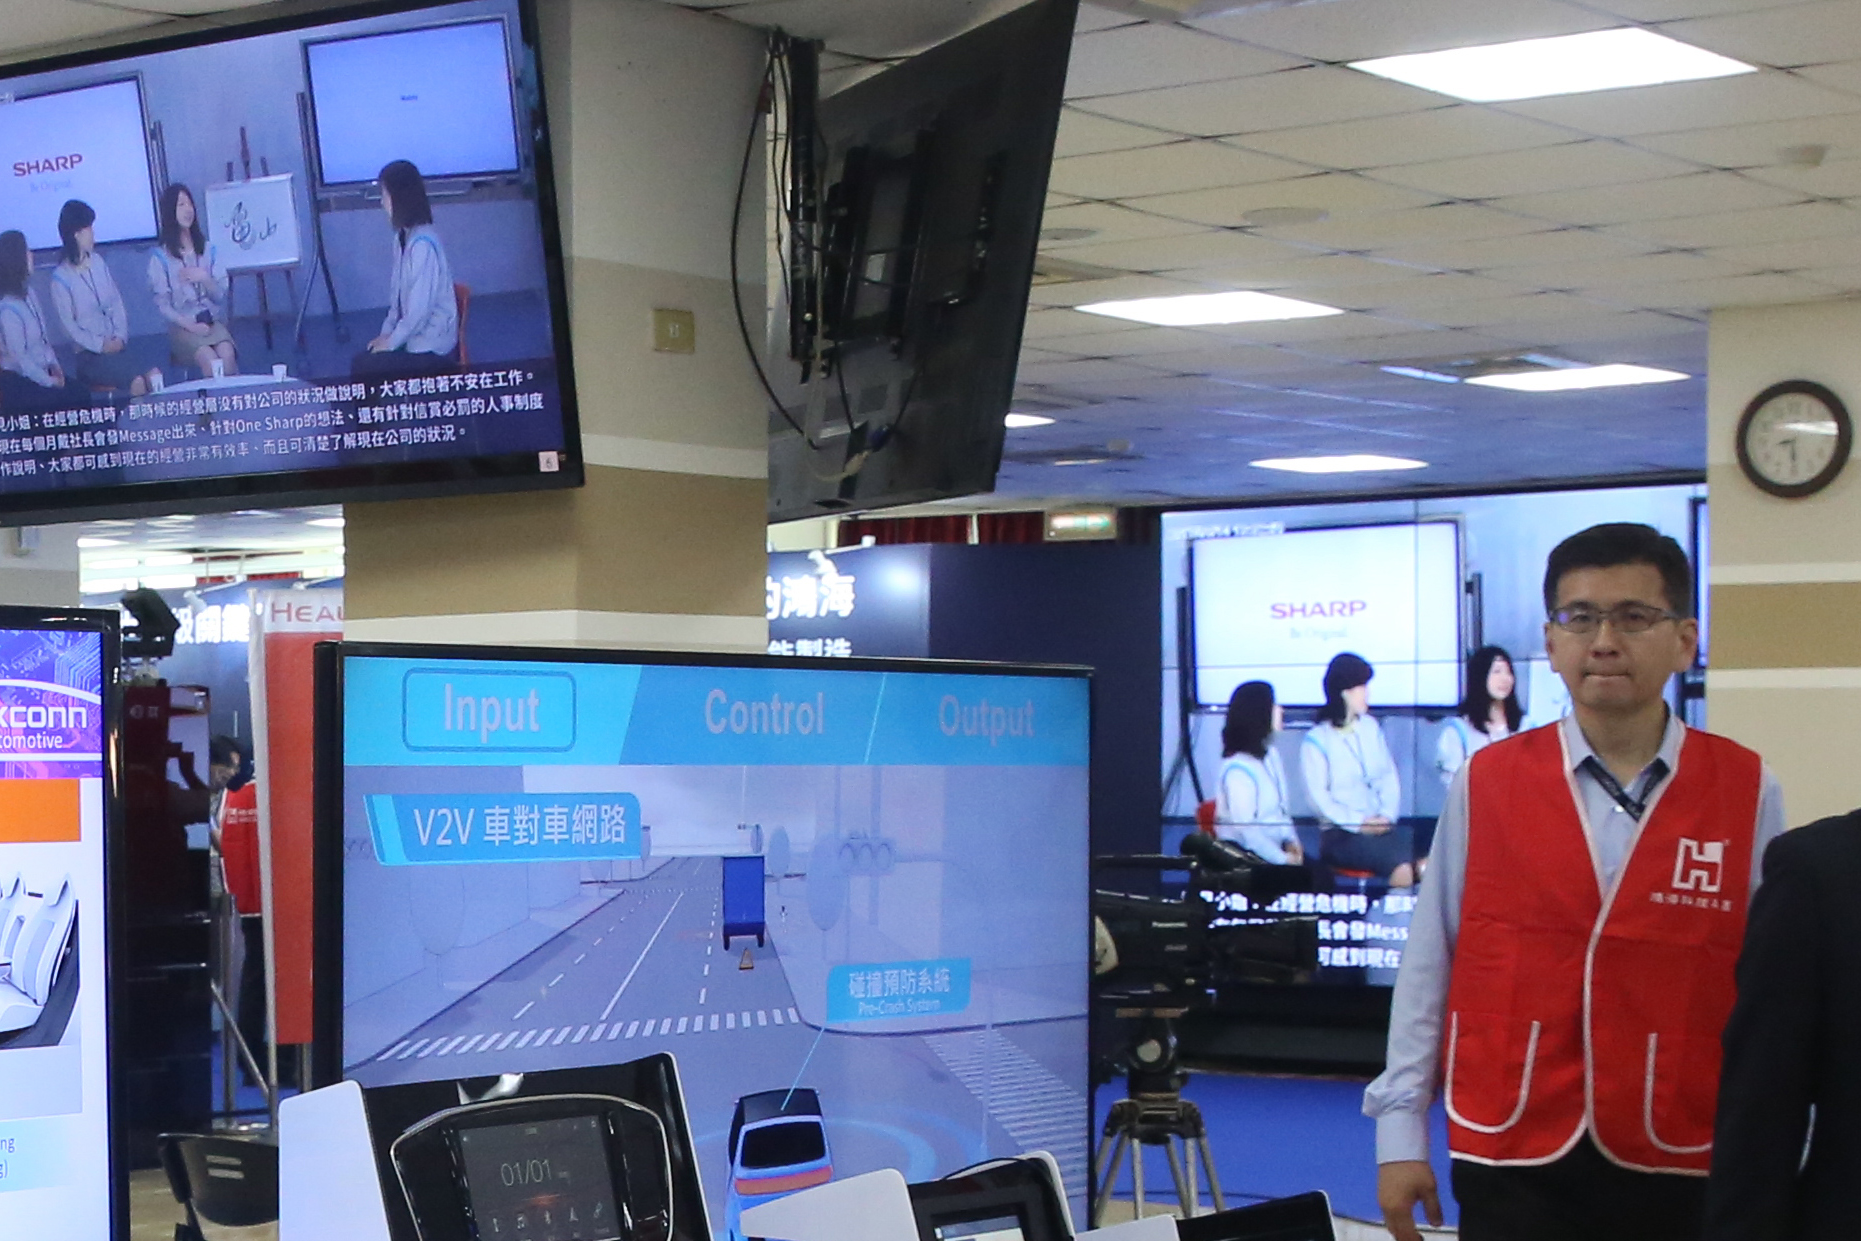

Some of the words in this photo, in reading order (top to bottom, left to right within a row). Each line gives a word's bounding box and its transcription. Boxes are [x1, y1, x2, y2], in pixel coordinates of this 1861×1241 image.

[13, 153, 83, 177] SHARP
[1270, 599, 1367, 620] SHARP
[443, 682, 541, 744] Input
[704, 688, 825, 737] Control
[940, 694, 1036, 748] Output
[414, 808, 474, 846] V2V
[482, 802, 627, 847] 車對車網路
[848, 967, 951, 999] 碰撞預防系統
[500, 1158, 552, 1186] 01/01
